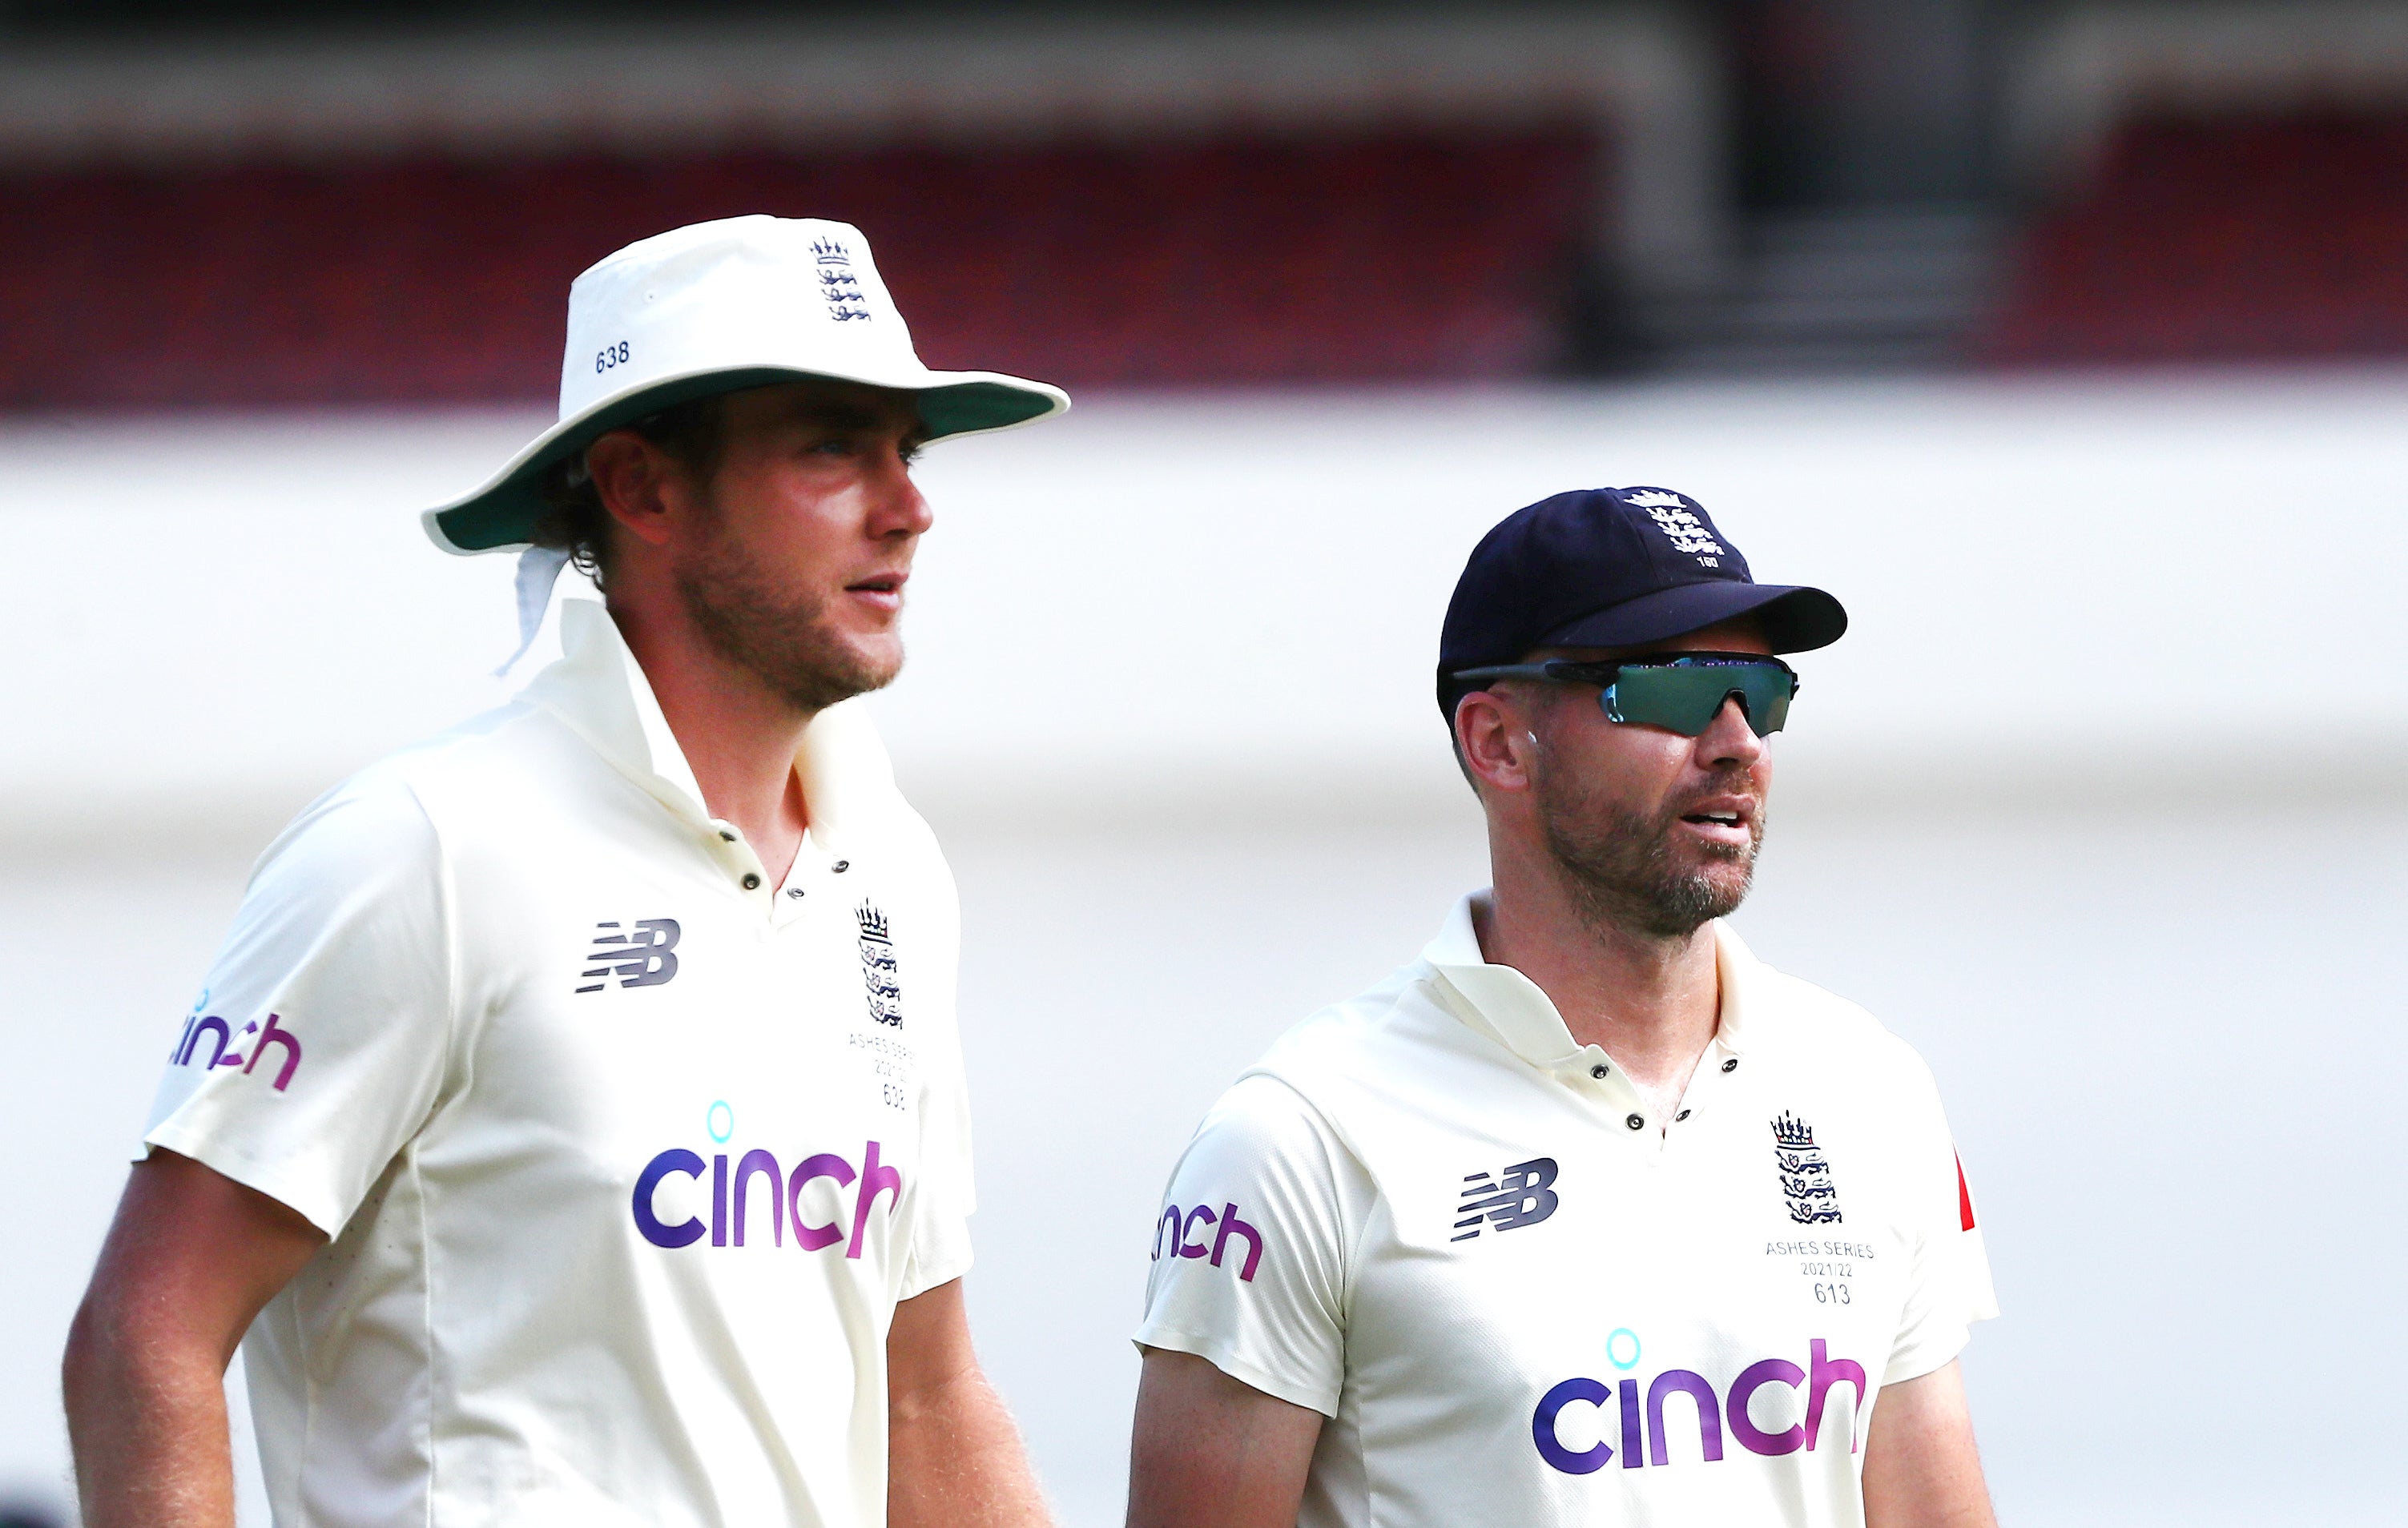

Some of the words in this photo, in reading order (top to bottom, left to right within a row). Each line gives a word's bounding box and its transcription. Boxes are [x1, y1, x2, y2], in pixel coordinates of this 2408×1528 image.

[596, 340, 630, 374] 638
[574, 918, 681, 994] NB
[170, 987, 302, 1092] inch
[849, 1033, 888, 1053] ASHES
[631, 1100, 902, 1260] cinch
[1450, 1157, 1559, 1243] NB
[1151, 1201, 1263, 1283] nch
[1766, 1240, 1819, 1255] ASHES
[1823, 1240, 1874, 1259] SERIES
[1800, 1262, 1852, 1277] 2021/22
[1814, 1282, 1850, 1305] 613
[1532, 1327, 1867, 1475] cinch
